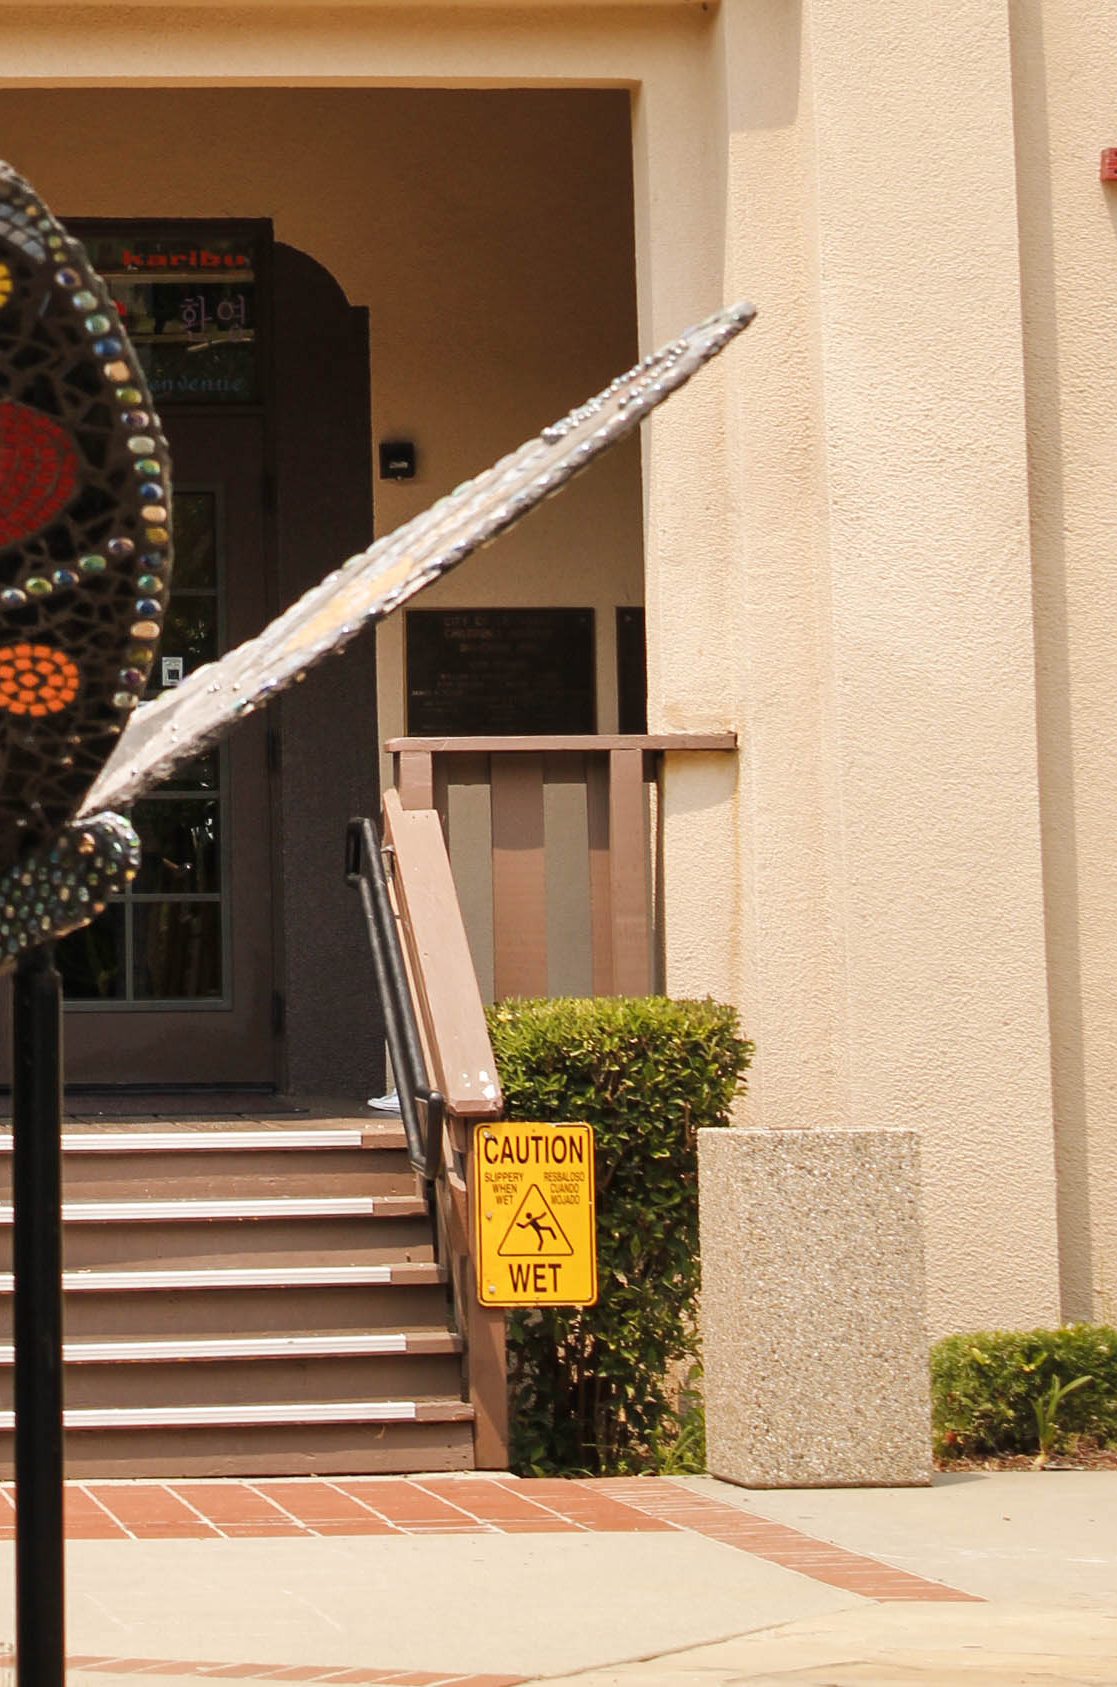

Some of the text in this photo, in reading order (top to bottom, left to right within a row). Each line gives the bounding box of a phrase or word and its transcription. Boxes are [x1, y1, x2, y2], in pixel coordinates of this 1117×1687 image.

[180, 295, 246, 342] 환영
[484, 1135, 583, 1164] CAUTION
[484, 1172, 524, 1182] SLIPPERY
[543, 1172, 585, 1182] RESBALOSO
[492, 1184, 517, 1194] WHEN
[550, 1184, 580, 1194] CUANDO
[496, 1195, 514, 1205] WET
[550, 1195, 581, 1205] MOJADO
[509, 1264, 561, 1293] WET
